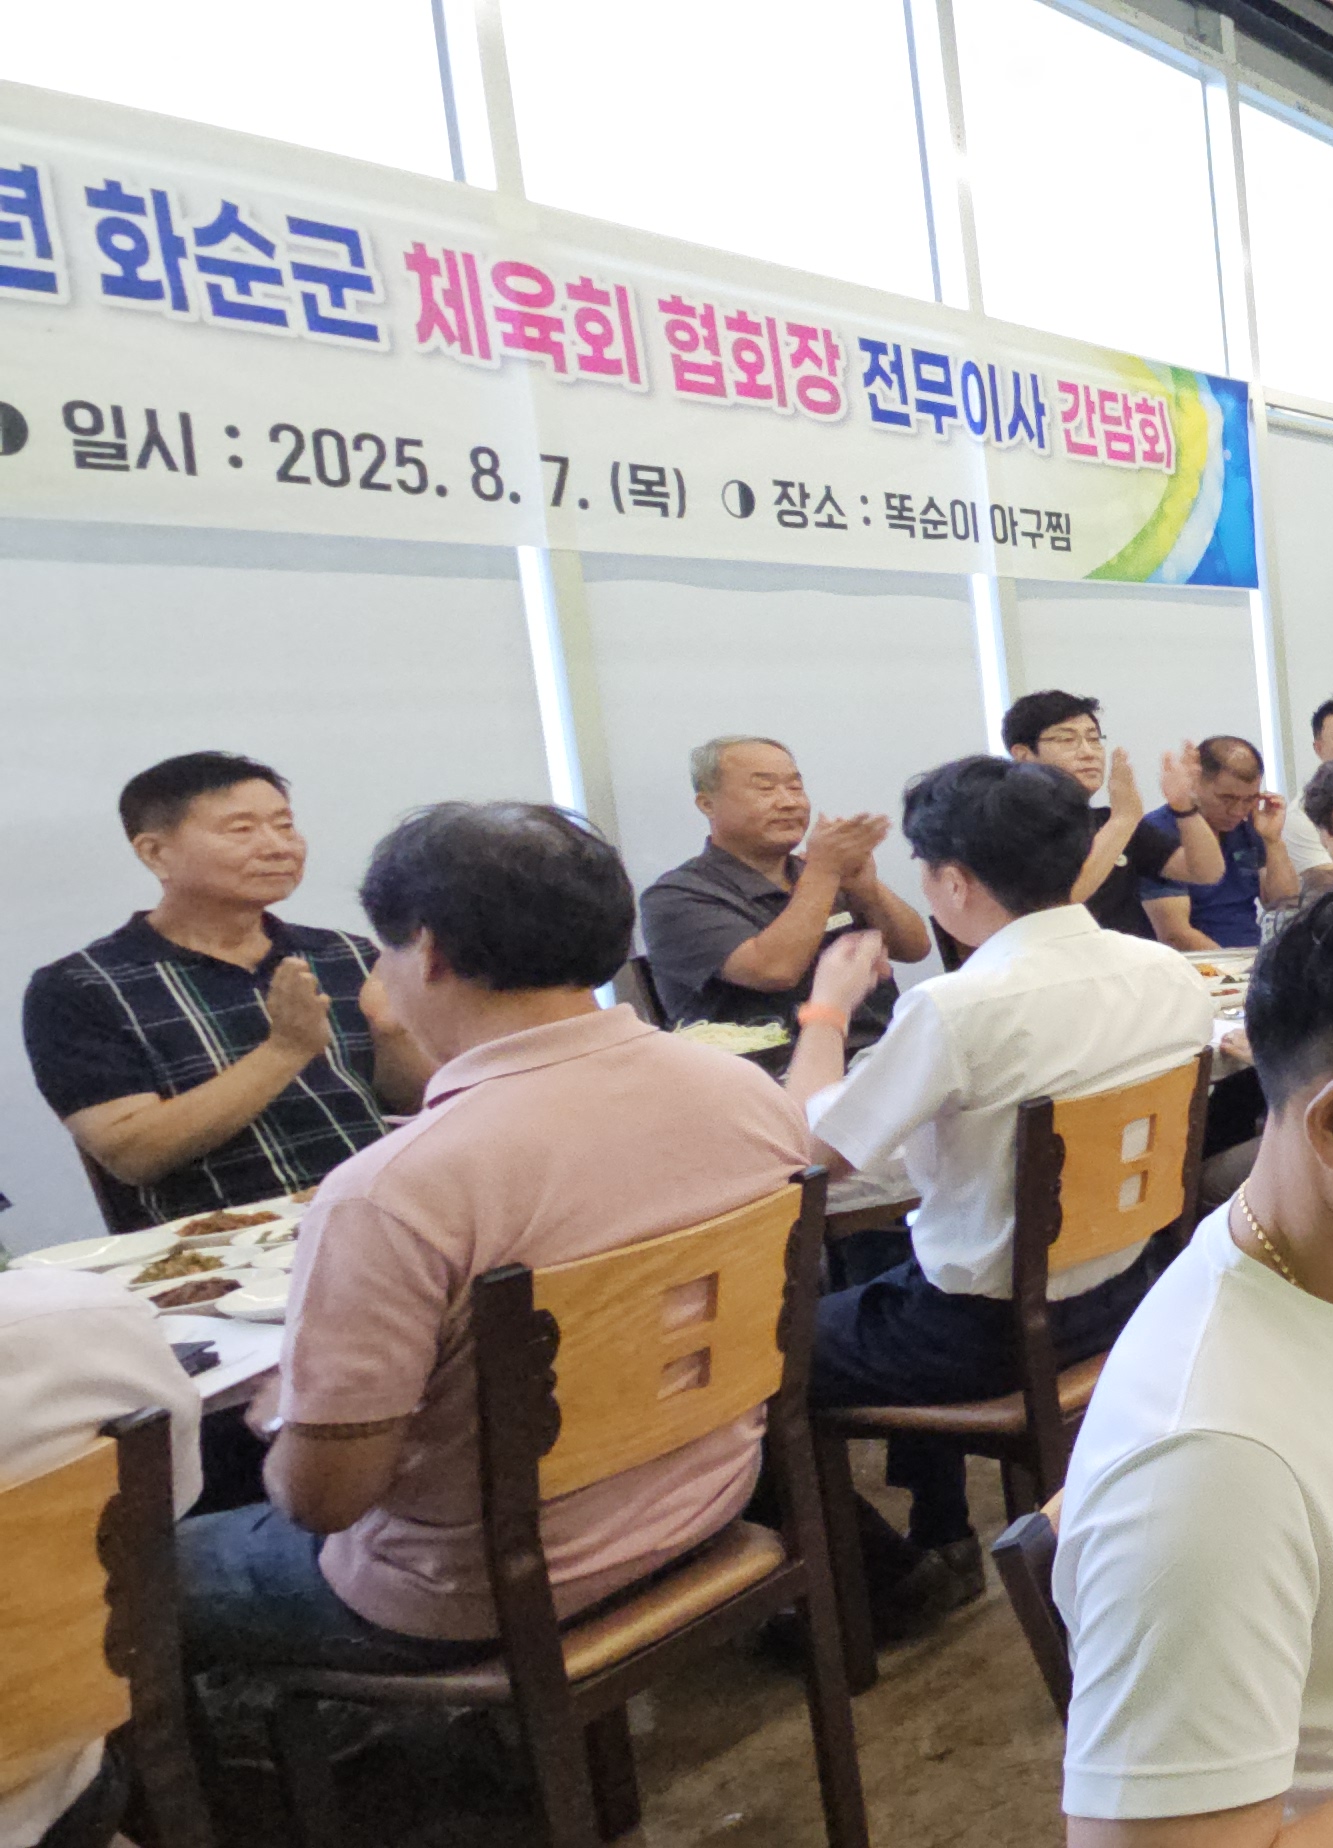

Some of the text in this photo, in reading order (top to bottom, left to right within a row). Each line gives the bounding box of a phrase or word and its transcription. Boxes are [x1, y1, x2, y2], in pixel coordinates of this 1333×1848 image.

[84, 178, 381, 344] 화순군
[403, 242, 642, 386] 체육회
[657, 294, 841, 417] 협회장
[857, 337, 1047, 449] 전무이사
[1055, 380, 1174, 470] 간담회
[62, 400, 197, 476] 일시
[268, 423, 449, 498] 2025.
[470, 446, 521, 505] 8.
[538, 454, 590, 511] 7.
[610, 461, 687, 519] (목)
[772, 479, 848, 530] 장소
[884, 492, 980, 543] 똑순이
[990, 503, 1072, 552] 아구찜
